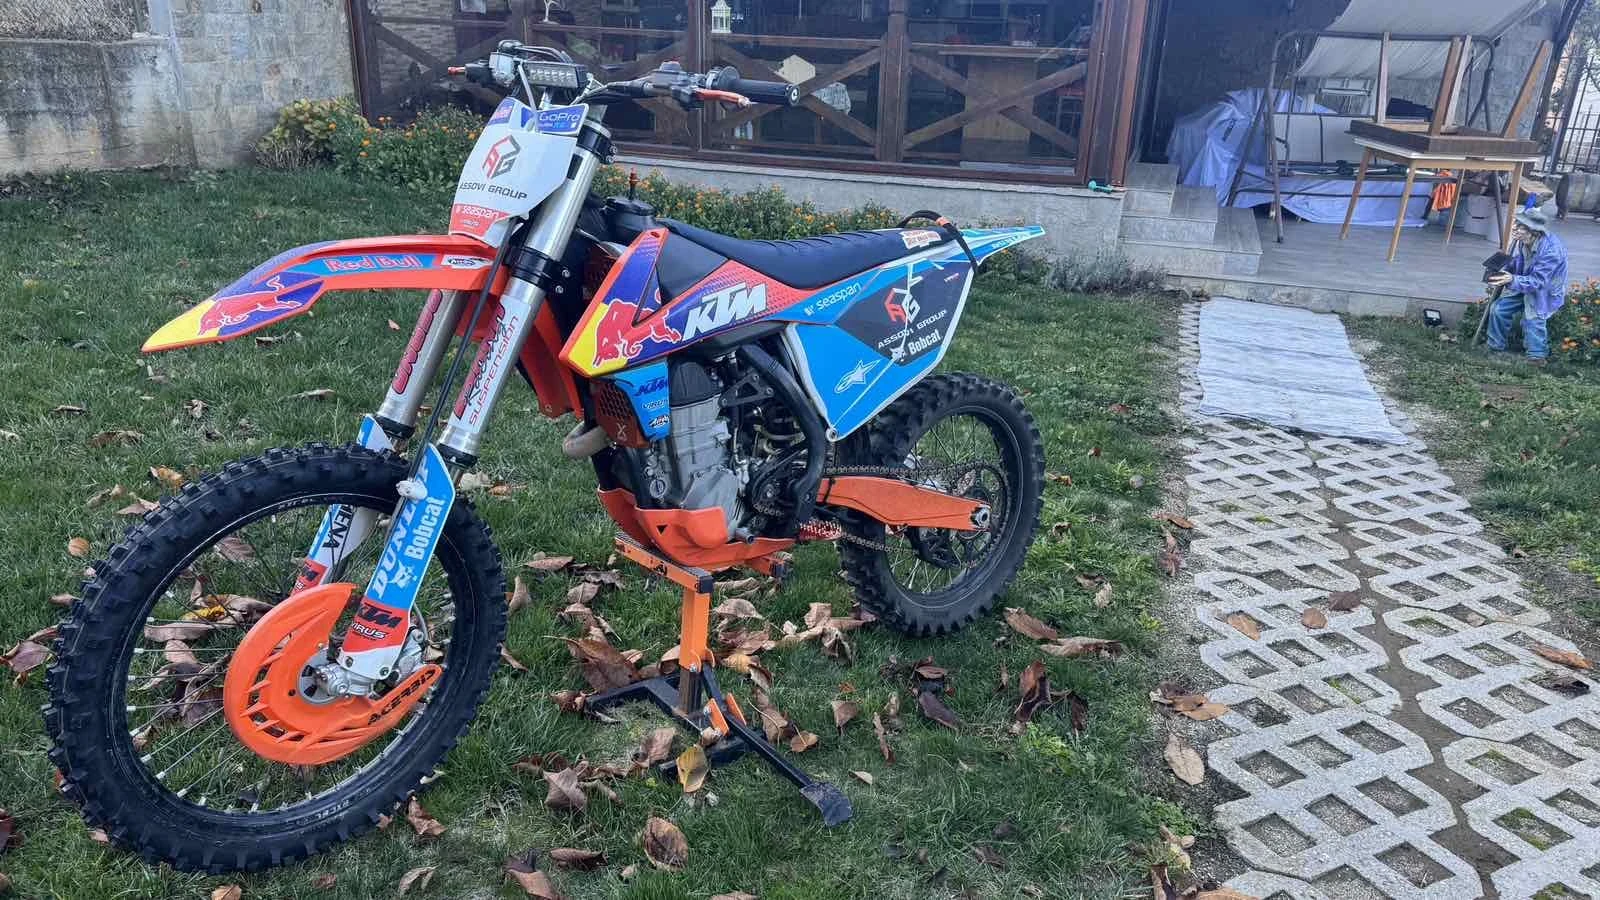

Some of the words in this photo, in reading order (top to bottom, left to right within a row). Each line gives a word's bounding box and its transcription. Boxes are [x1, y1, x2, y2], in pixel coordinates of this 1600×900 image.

[539, 111, 580, 122] GoPro
[488, 185, 528, 200] GROUP
[462, 205, 499, 219] seaspan
[325, 257, 372, 271] Red
[375, 255, 422, 269] Bull
[818, 282, 861, 308] seaspan
[682, 282, 766, 341] KTM
[916, 310, 948, 330] GROUP
[908, 330, 942, 356] Bobcat
[470, 316, 519, 426] SUSPENSION
[404, 497, 443, 560] Bobcat
